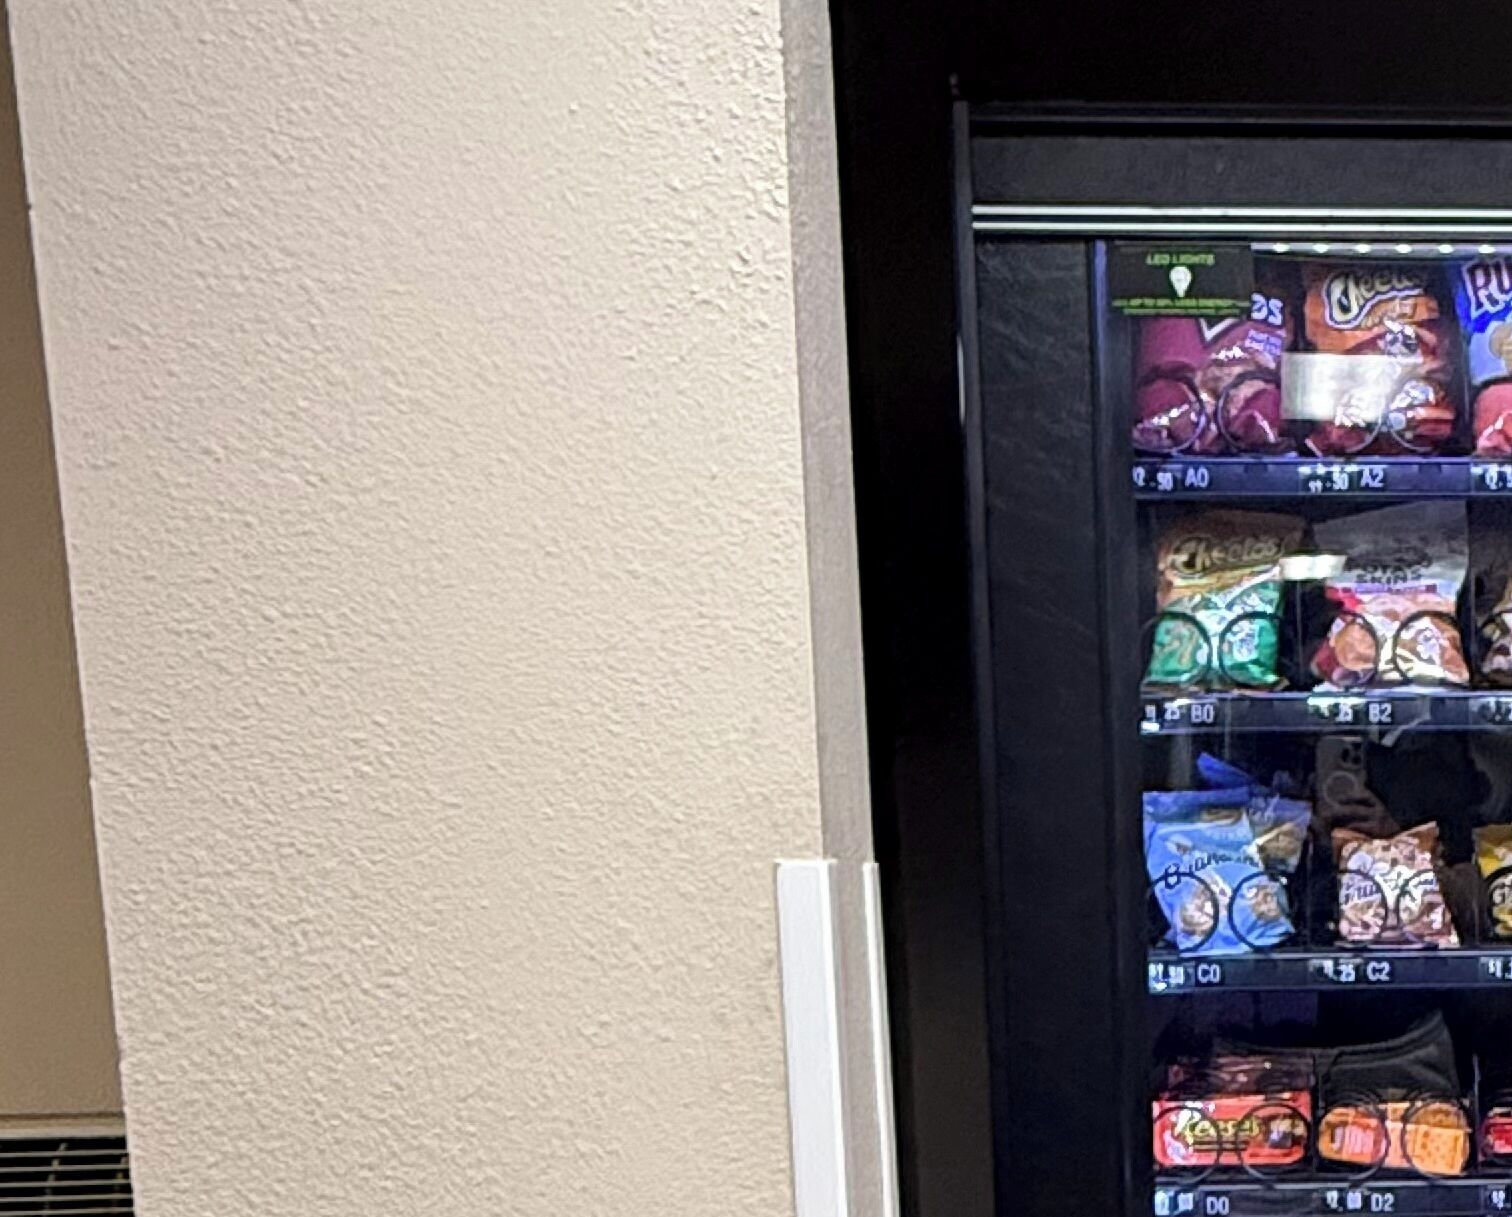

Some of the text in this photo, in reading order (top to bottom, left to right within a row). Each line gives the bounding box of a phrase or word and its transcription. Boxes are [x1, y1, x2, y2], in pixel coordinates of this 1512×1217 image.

[1184, 466, 1210, 488] A0
[1361, 466, 1385, 488] A2
[1190, 704, 1215, 724] B0
[1368, 702, 1393, 723] B2
[1197, 963, 1221, 983] C0
[1366, 961, 1390, 982] C2
[1205, 1196, 1230, 1216] D0
[1370, 1193, 1395, 1212] D2
